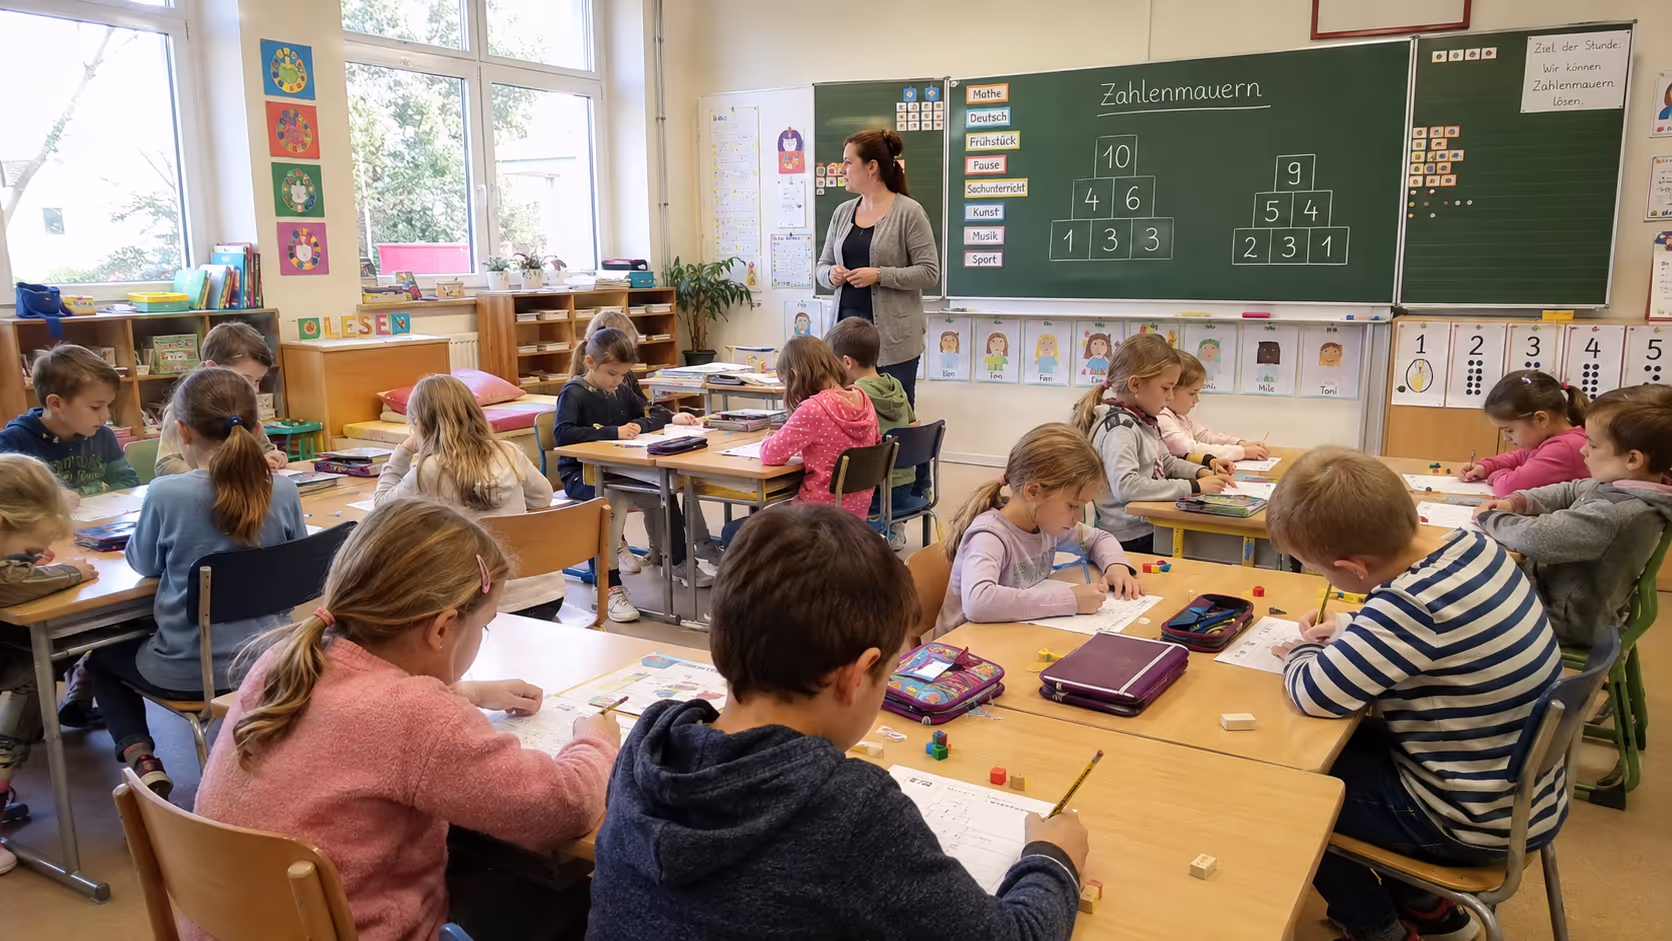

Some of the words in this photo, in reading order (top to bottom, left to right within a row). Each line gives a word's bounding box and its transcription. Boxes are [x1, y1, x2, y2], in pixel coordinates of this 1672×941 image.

[1534, 42, 1556, 54] Ziel
[1562, 40, 1579, 52] der
[1585, 39, 1622, 51] Stunde:
[1542, 64, 1560, 74] Wir
[1566, 62, 1602, 73] können
[973, 89, 1002, 99] Mathe
[1100, 79, 1263, 106] Zahlenmauern
[1532, 80, 1616, 92] Zahlenmauern
[970, 112, 1007, 123] Deutsch
[969, 135, 1017, 147] Frühstück
[973, 160, 1000, 170] Pause
[1103, 144, 1131, 169] 10
[1287, 161, 1301, 185] 9
[1084, 187, 1100, 212] 4
[1125, 185, 1141, 210] 6
[973, 207, 1000, 217] Kunst
[1264, 200, 1279, 222] 5
[1303, 199, 1318, 222] 4
[972, 231, 998, 241] Musik
[1063, 228, 1073, 253] 1
[1102, 227, 1118, 252] 3
[1144, 227, 1160, 252] 3
[1243, 236, 1258, 258] 2
[1281, 236, 1296, 258] 3
[1321, 235, 1331, 257] 1
[972, 255, 997, 266] Sport
[1415, 334, 1426, 354] 1
[1469, 335, 1484, 356] 2
[1525, 336, 1541, 357] 3
[1584, 337, 1601, 359] 4
[1646, 339, 1663, 360] 5
[1320, 385, 1338, 396] Toni
